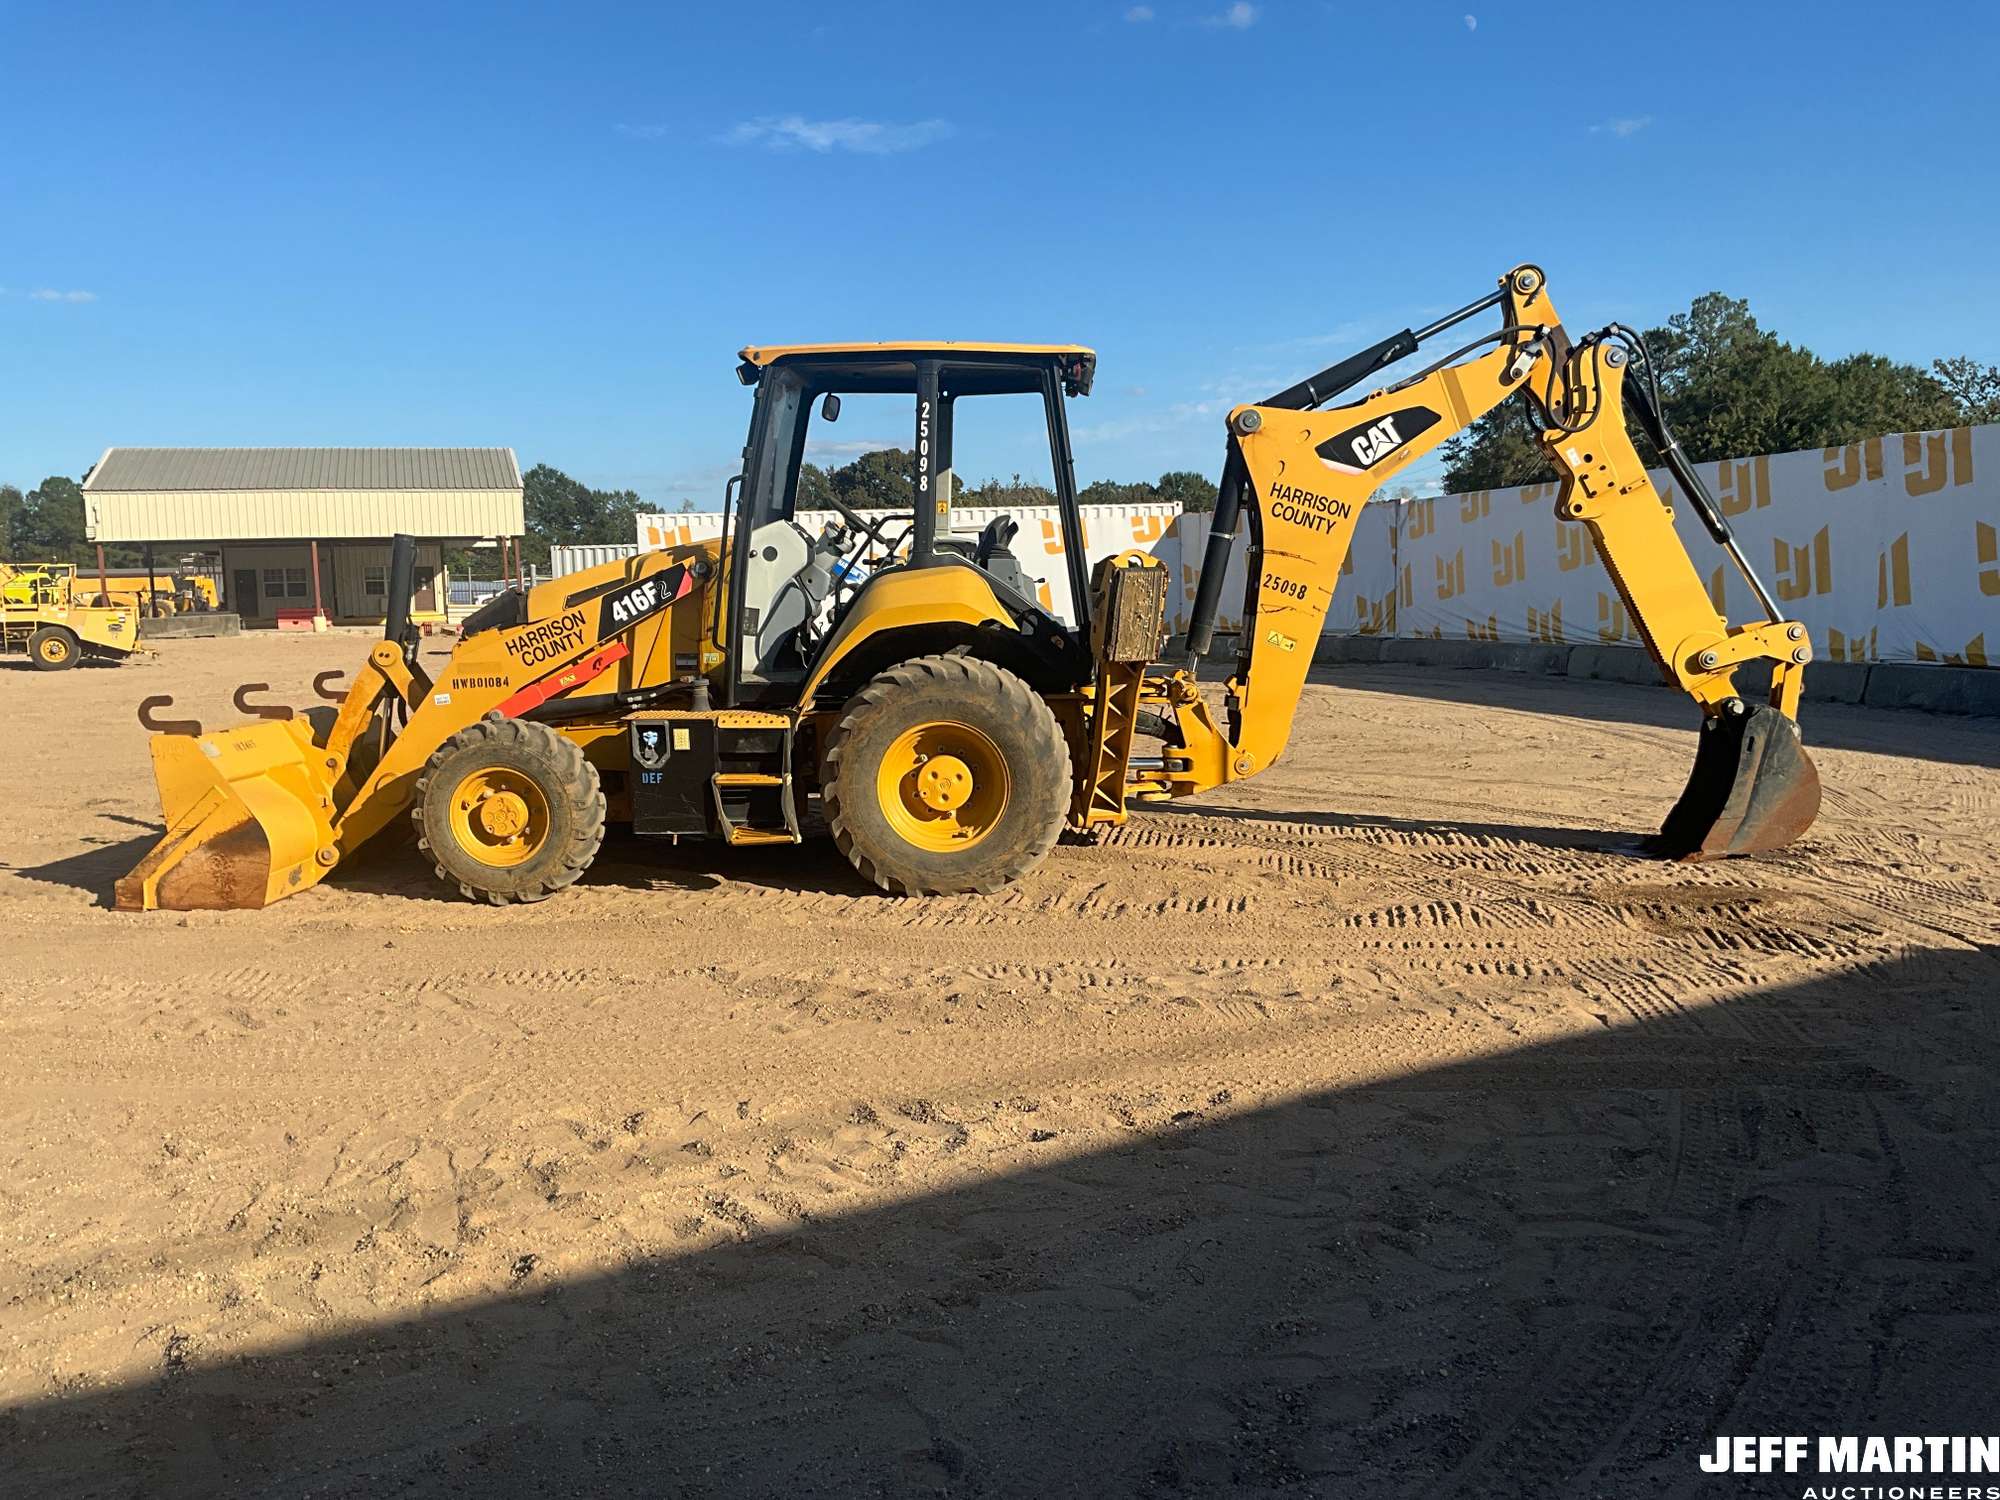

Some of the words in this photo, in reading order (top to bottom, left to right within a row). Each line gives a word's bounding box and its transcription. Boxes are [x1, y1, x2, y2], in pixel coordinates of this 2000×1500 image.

[919, 401, 931, 492] 25098
[1350, 416, 1402, 466] CAT
[1269, 482, 1351, 520] HARRISON
[1271, 501, 1337, 535] COUNTY
[1263, 573, 1308, 600] 25098
[505, 610, 586, 656] HARRISON
[521, 628, 584, 667] COUNTY
[452, 675, 509, 690] HWB01084
[641, 772, 663, 784] DEF
